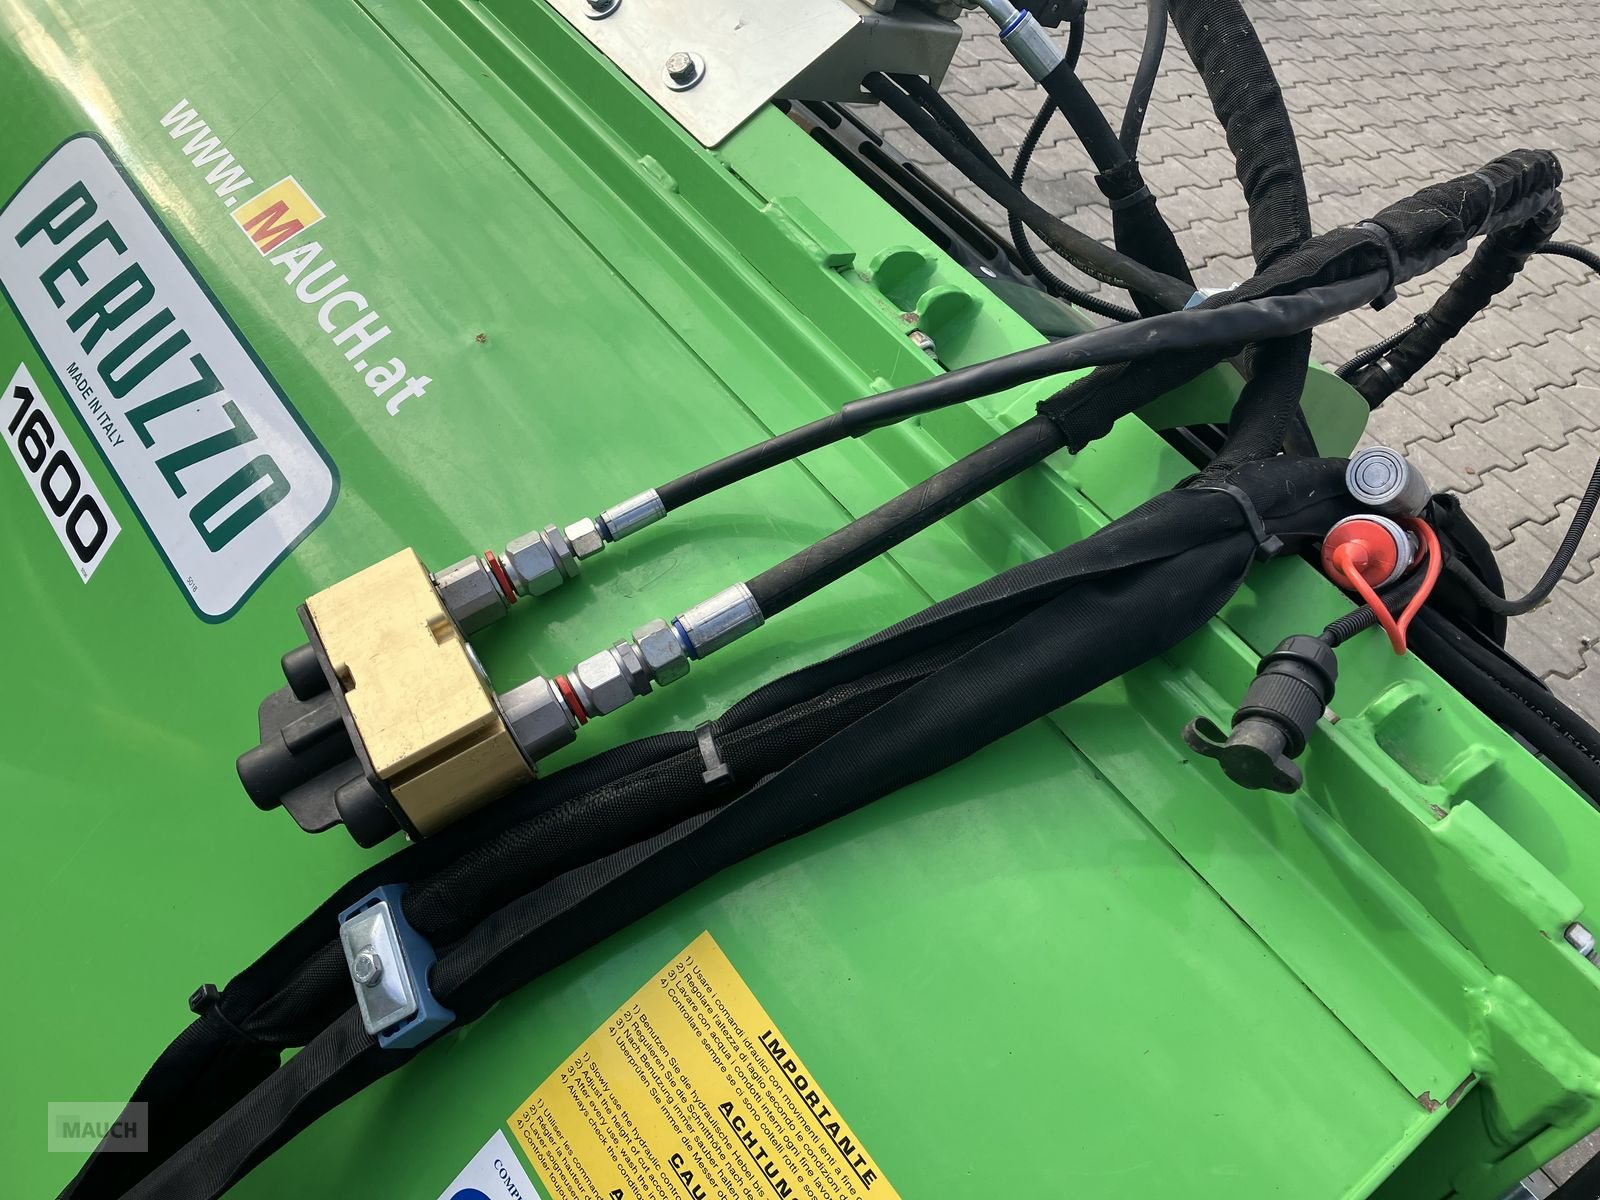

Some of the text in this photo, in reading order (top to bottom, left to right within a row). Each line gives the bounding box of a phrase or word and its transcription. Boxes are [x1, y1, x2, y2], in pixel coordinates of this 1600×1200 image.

[160, 98, 432, 416] www.MAUCH.at
[15, 180, 291, 553] PERUZZO
[66, 362, 124, 447] MADE IN ITALY
[8, 386, 108, 563] 1600
[516, 1119, 524, 1129] 4)
[522, 1111, 531, 1122] 3)
[529, 1122, 547, 1148] Laver
[529, 1104, 537, 1115] 2)
[555, 1146, 562, 1157] la
[561, 1156, 585, 1193] hauteur
[537, 1098, 544, 1108] 1)
[543, 1108, 564, 1140] Utiliser
[562, 1140, 573, 1156] les
[560, 1074, 568, 1084] 4)
[566, 1085, 589, 1117] Always
[588, 1117, 607, 1146] check
[606, 1145, 618, 1162] the
[567, 1065, 576, 1077] 3)
[574, 1077, 591, 1098] After
[589, 1100, 607, 1126] every
[606, 1126, 619, 1148] use,
[620, 1148, 638, 1174] wash
[636, 1174, 649, 1191] the
[574, 1058, 583, 1069] 2)
[581, 1070, 603, 1099] Adjust
[600, 1098, 612, 1114] the
[611, 1114, 632, 1145] height
[630, 1145, 640, 1156] of
[637, 1157, 650, 1173] cut
[583, 1051, 590, 1062] 1)
[589, 1061, 610, 1092] Slowly
[608, 1092, 622, 1110] use
[620, 1110, 632, 1127] the
[631, 1126, 661, 1171] hydraulic
[608, 1027, 617, 1037] 4)
[649, 1087, 661, 1104] Sie
[660, 1103, 683, 1134] immer
[681, 1136, 693, 1152] die
[692, 1151, 718, 1188] Messer
[615, 1017, 625, 1030] 3)
[623, 1028, 641, 1054] Nach
[639, 1053, 674, 1104] Benutzung
[672, 1103, 695, 1134] immer
[693, 1135, 719, 1168] sauber
[623, 1010, 633, 1022] 2)
[631, 1021, 665, 1071] Regulieren
[664, 1070, 676, 1088] Sie
[675, 1088, 687, 1104] die
[686, 1103, 726, 1161] Schnitthöhe
[724, 1161, 744, 1187] nach
[632, 1004, 765, 1197] 1) Benutzen Sie die hydraulische Hebel bis
[660, 978, 669, 988] 4)
[667, 988, 702, 1037] Controllare
[701, 1038, 727, 1073] sempre
[726, 1073, 736, 1086] se
[735, 1087, 744, 1097] ci
[742, 1097, 761, 1122] sono
[760, 1122, 785, 1154] coltelli
[782, 1154, 799, 1174] rotti
[796, 1175, 804, 1183] e
[667, 969, 677, 981] 3)
[675, 980, 698, 1012] Lavare
[697, 1012, 711, 1031] con
[709, 1031, 732, 1060] acqua
[734, 1065, 763, 1103] condotti
[760, 1103, 785, 1134] interni
[782, 1135, 801, 1157] ogni
[798, 1156, 814, 1177] fine
[675, 962, 685, 974] 2)
[683, 972, 713, 1014] Regolare
[712, 1013, 740, 1052] l'altezza
[738, 1052, 748, 1063] di
[746, 1062, 766, 1089] taglio
[765, 1090, 796, 1131] secondo
[794, 1130, 804, 1142] le
[803, 1143, 841, 1193] condizioni
[685, 955, 694, 966] 1)
[692, 965, 712, 993] Usare
[714, 998, 745, 1038] comandi
[742, 1036, 771, 1074] idraulici
[768, 1074, 783, 1094] con
[782, 1093, 820, 1144] movimenti
[818, 1142, 837, 1166] lenti
[834, 1167, 842, 1175] a
[840, 1174, 856, 1195] fine
[761, 1029, 878, 1187] IMPORTANTE
[671, 1153, 708, 1200] CAU
